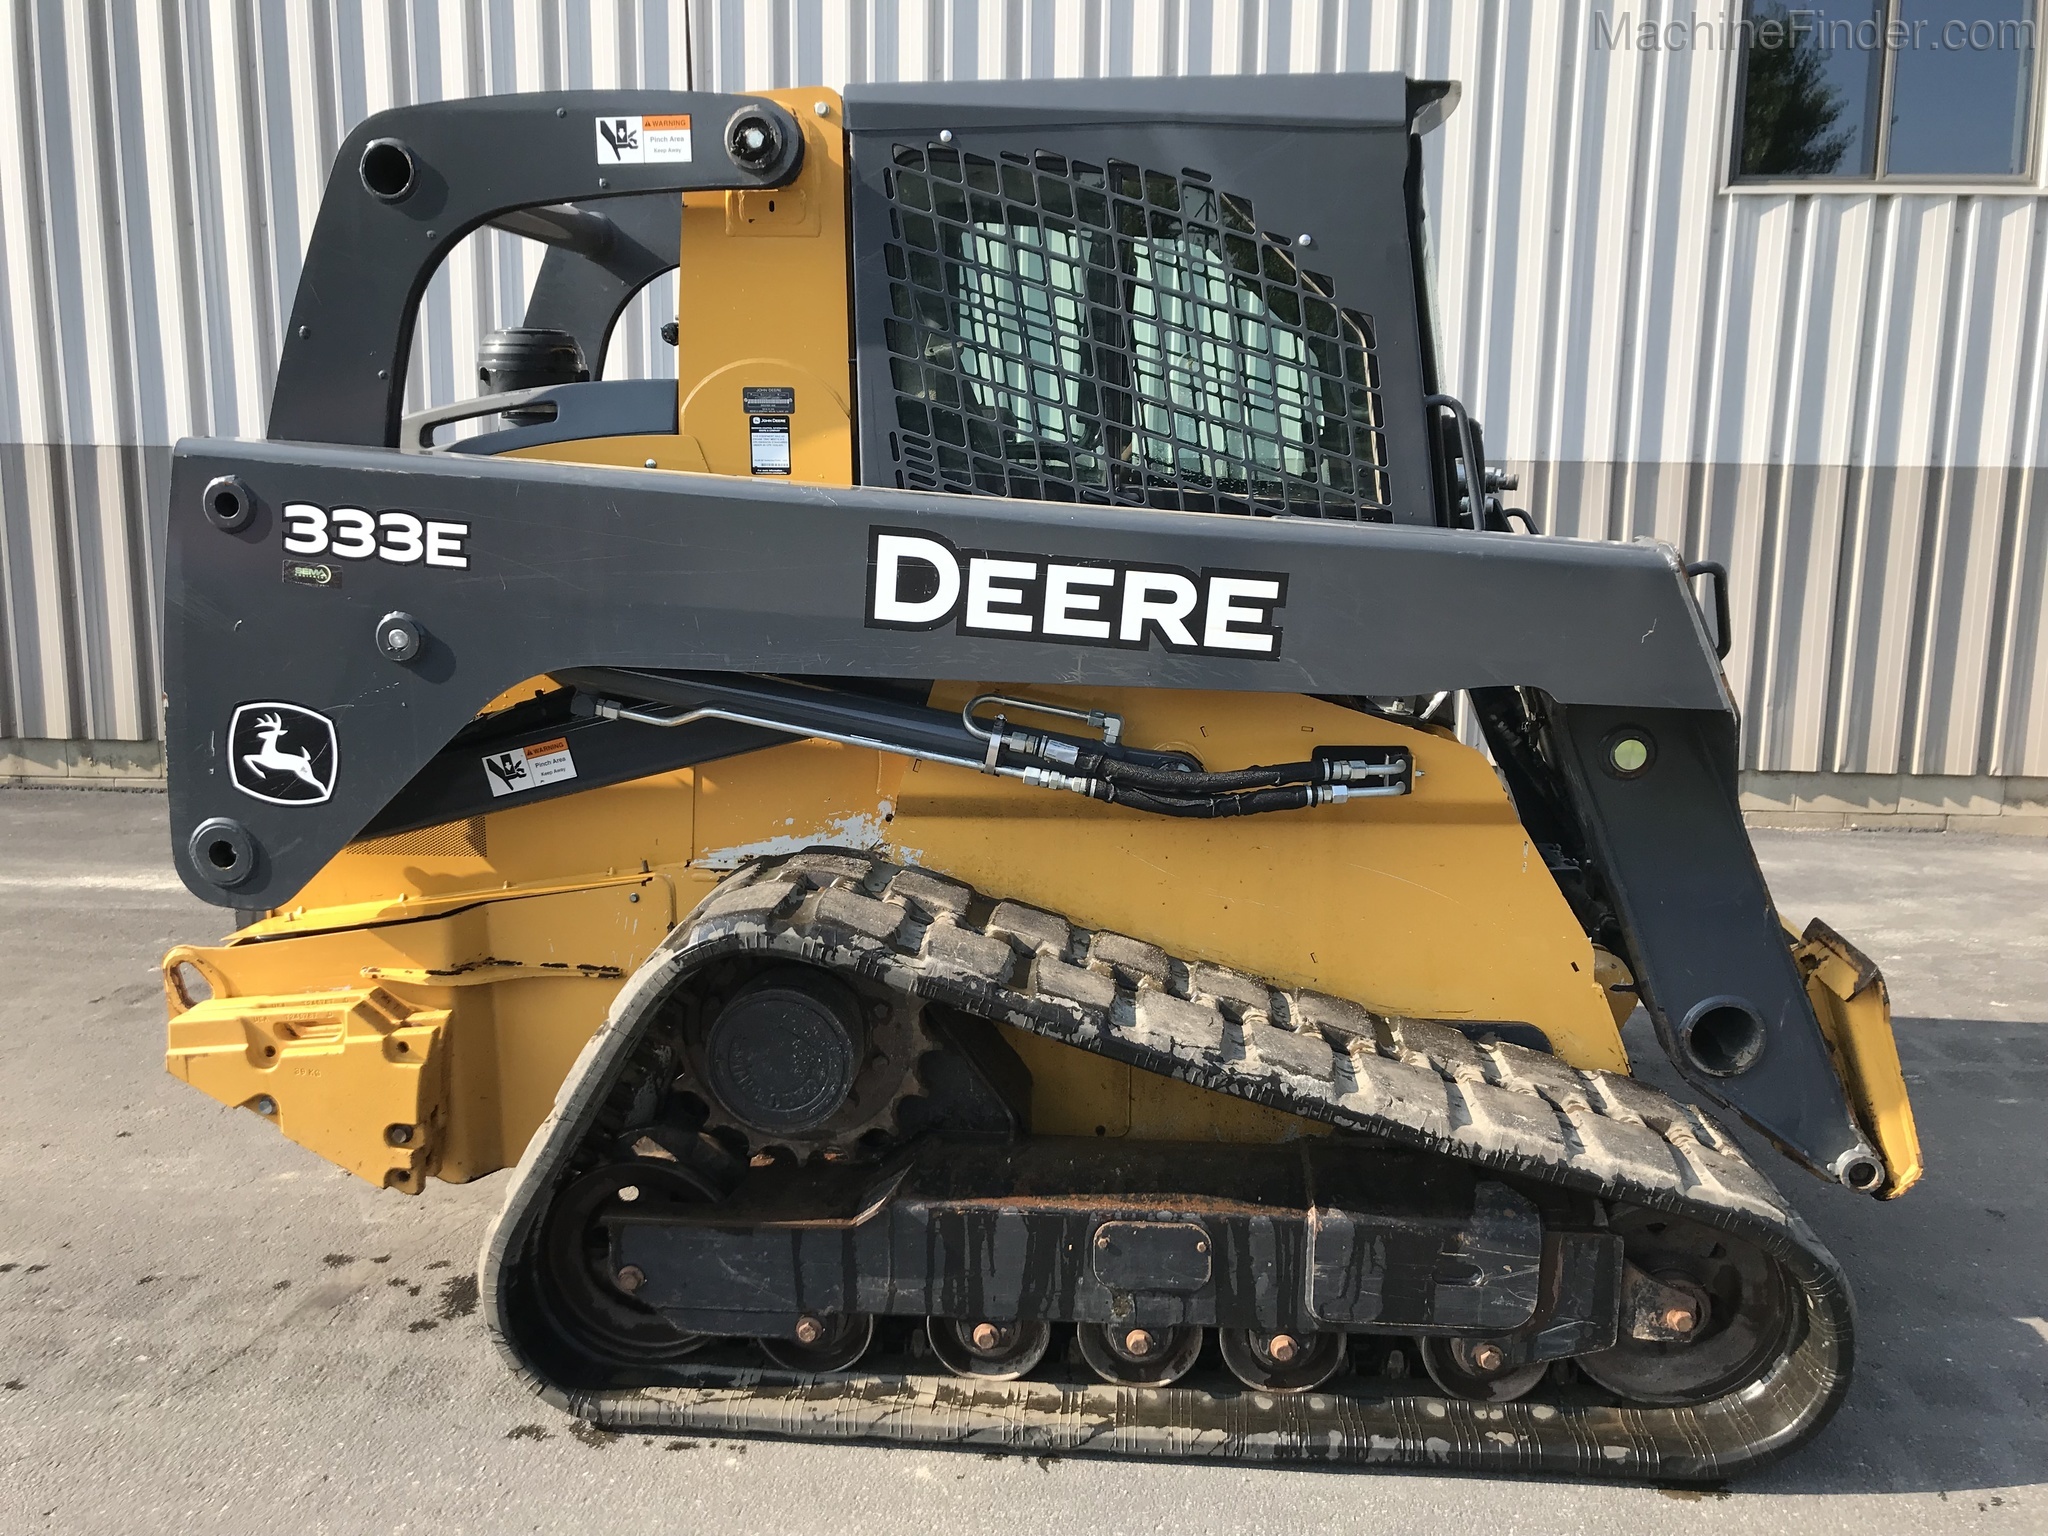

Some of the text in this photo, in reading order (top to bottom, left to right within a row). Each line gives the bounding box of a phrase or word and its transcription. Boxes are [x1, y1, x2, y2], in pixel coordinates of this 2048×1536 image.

[652, 119, 686, 127] WARNING
[285, 504, 468, 568] 333E
[294, 566, 327, 578] SEMA
[874, 534, 1279, 652] DEERE
[533, 741, 564, 754] WARNING
[535, 760, 552, 768] Pinch
